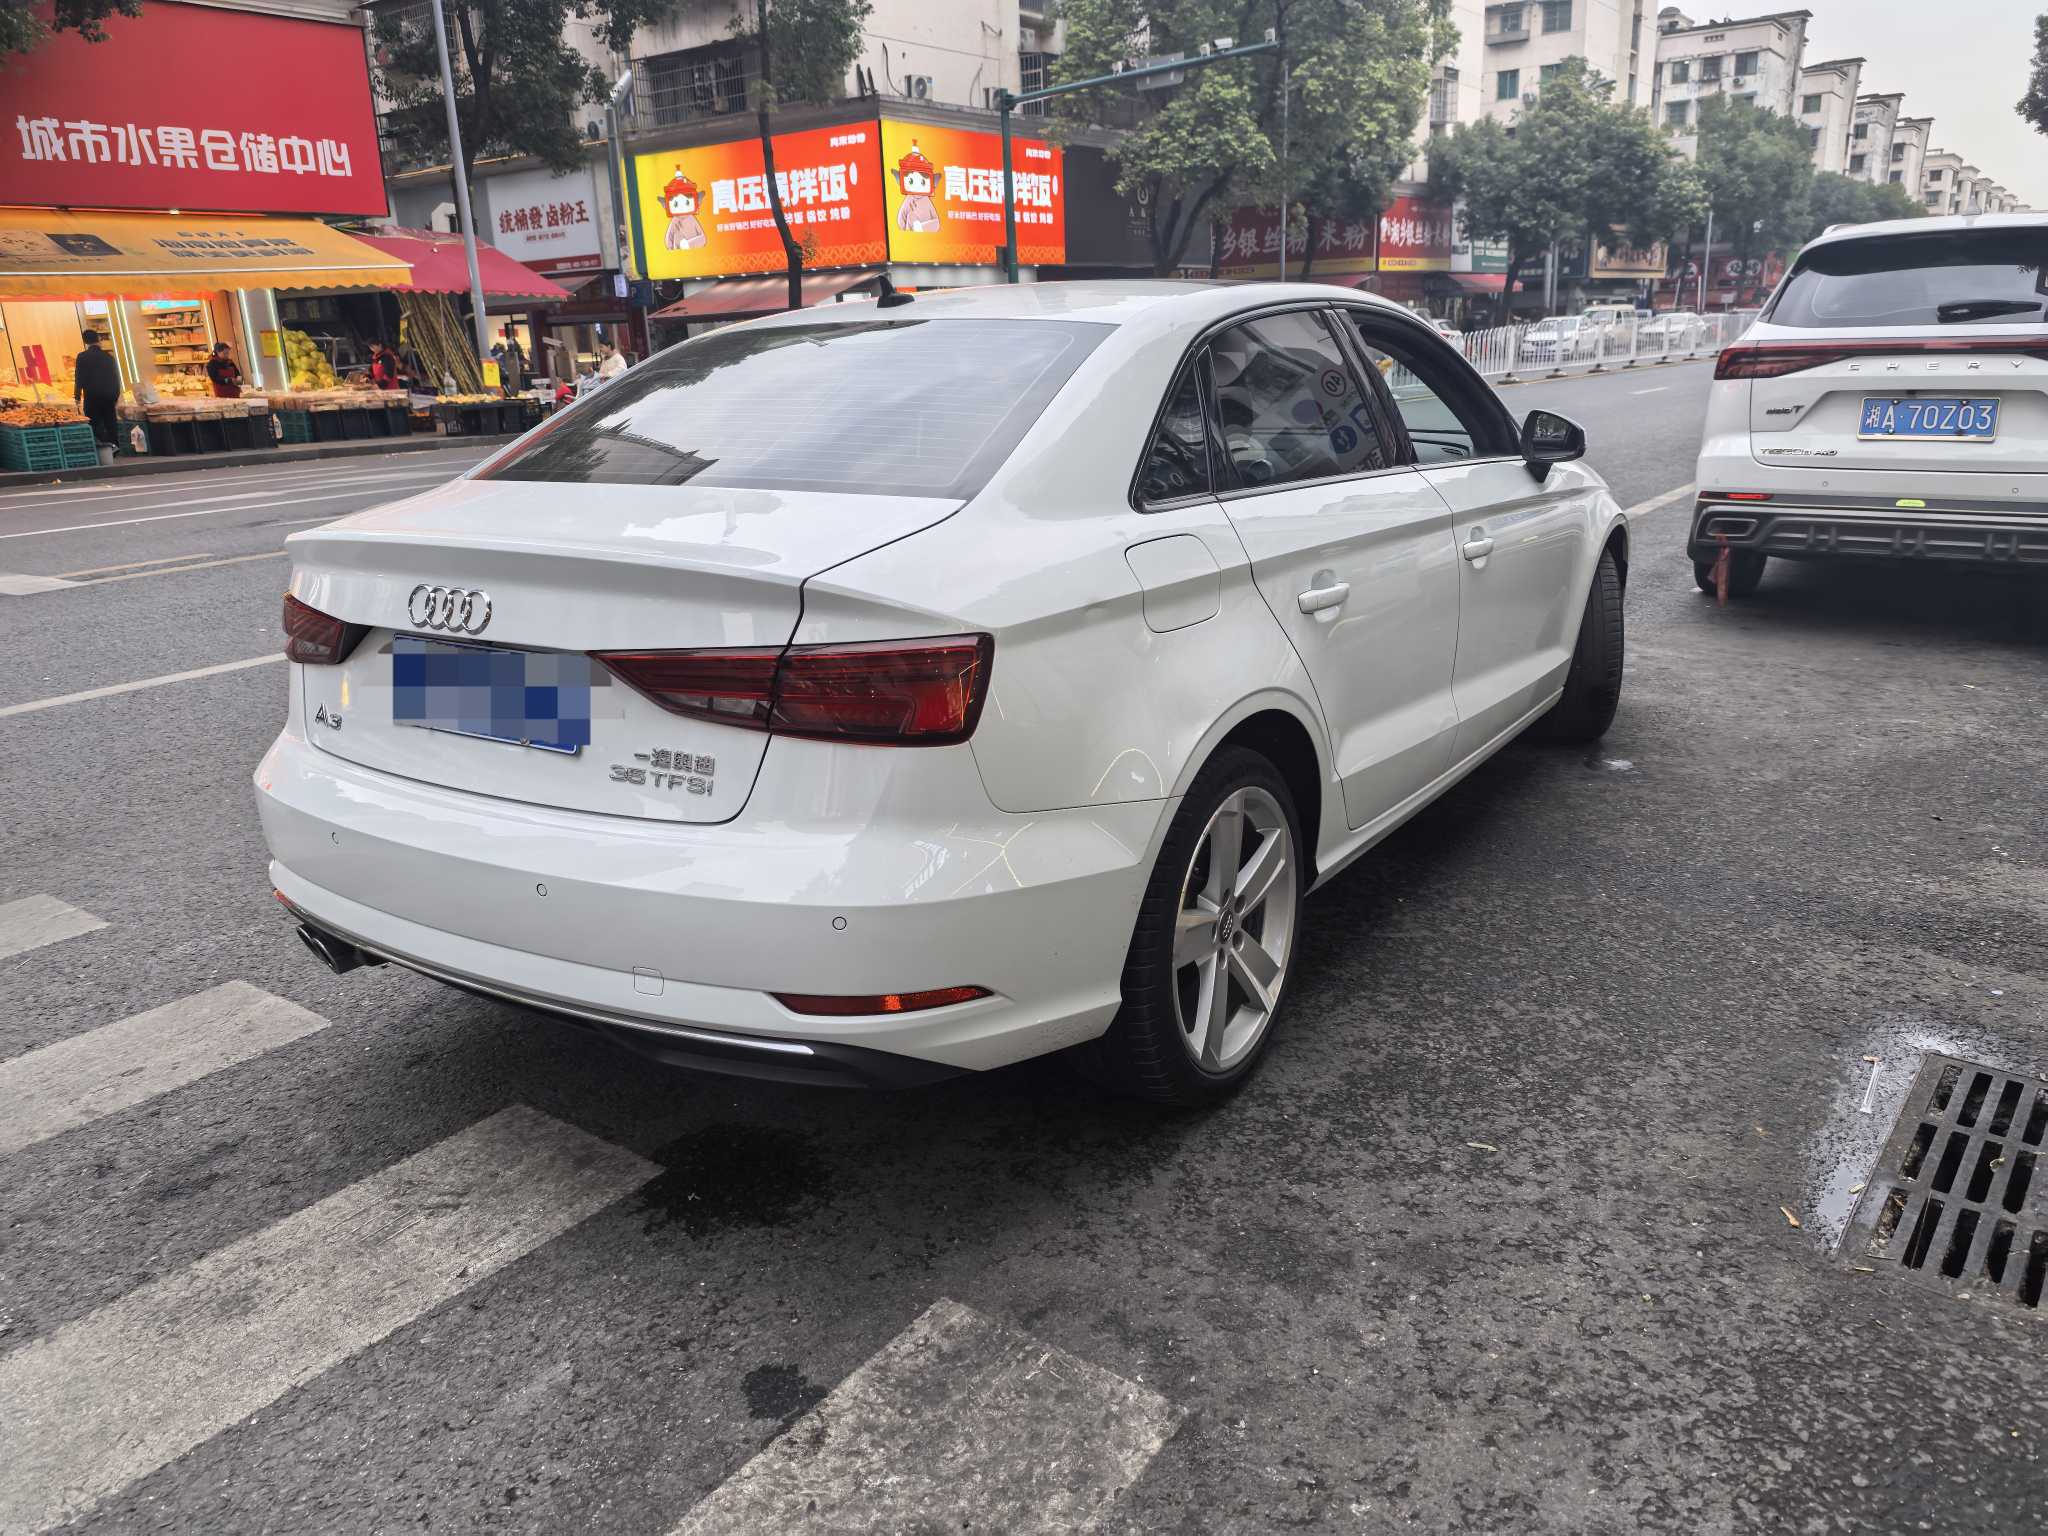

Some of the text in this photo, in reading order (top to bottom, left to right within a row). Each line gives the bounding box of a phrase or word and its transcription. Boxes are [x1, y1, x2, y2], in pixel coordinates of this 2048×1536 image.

[16, 115, 353, 177] 城市水果仓储中心
[1847, 359, 2025, 372] CHERY
[315, 703, 343, 731] A3
